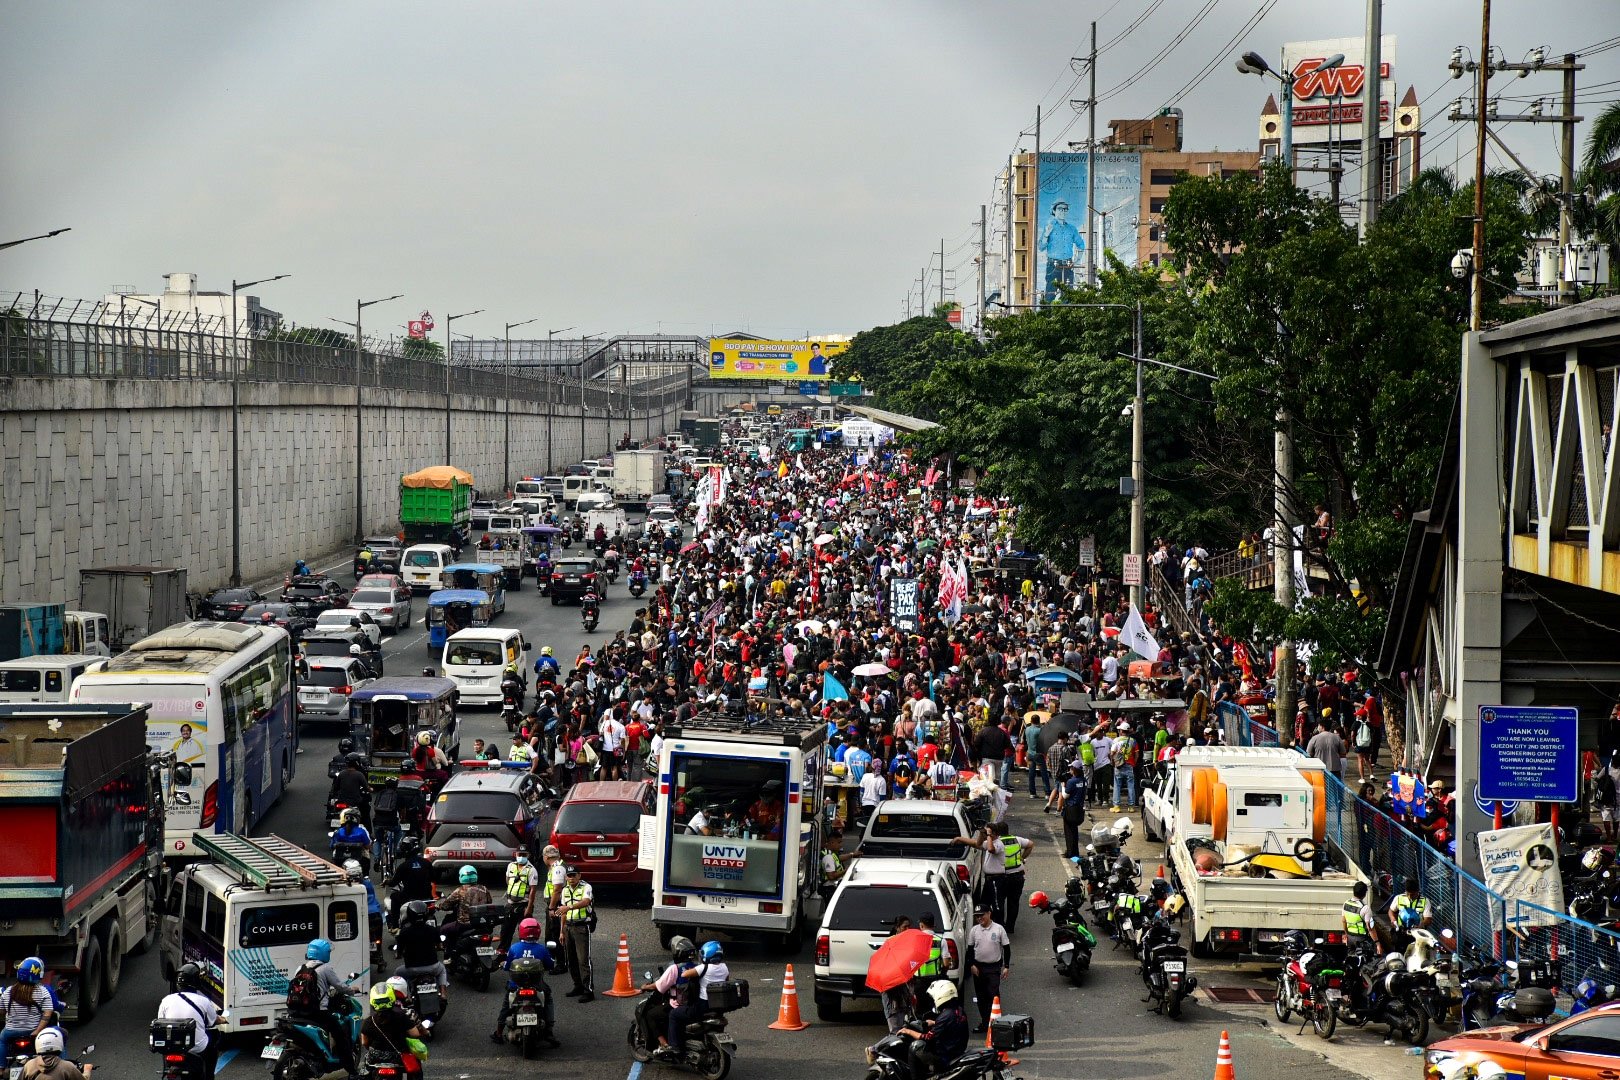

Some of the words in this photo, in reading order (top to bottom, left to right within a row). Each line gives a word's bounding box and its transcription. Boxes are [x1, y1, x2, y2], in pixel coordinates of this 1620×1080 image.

[896, 582, 917, 594] REJECT
[897, 593, 915, 606] PAX
[448, 851, 497, 860] PULISYA
[705, 845, 745, 858] UNTV
[1486, 849, 1522, 862] PLASTIC!
[703, 858, 744, 867] RADYO
[252, 922, 313, 934] CONVERGE
